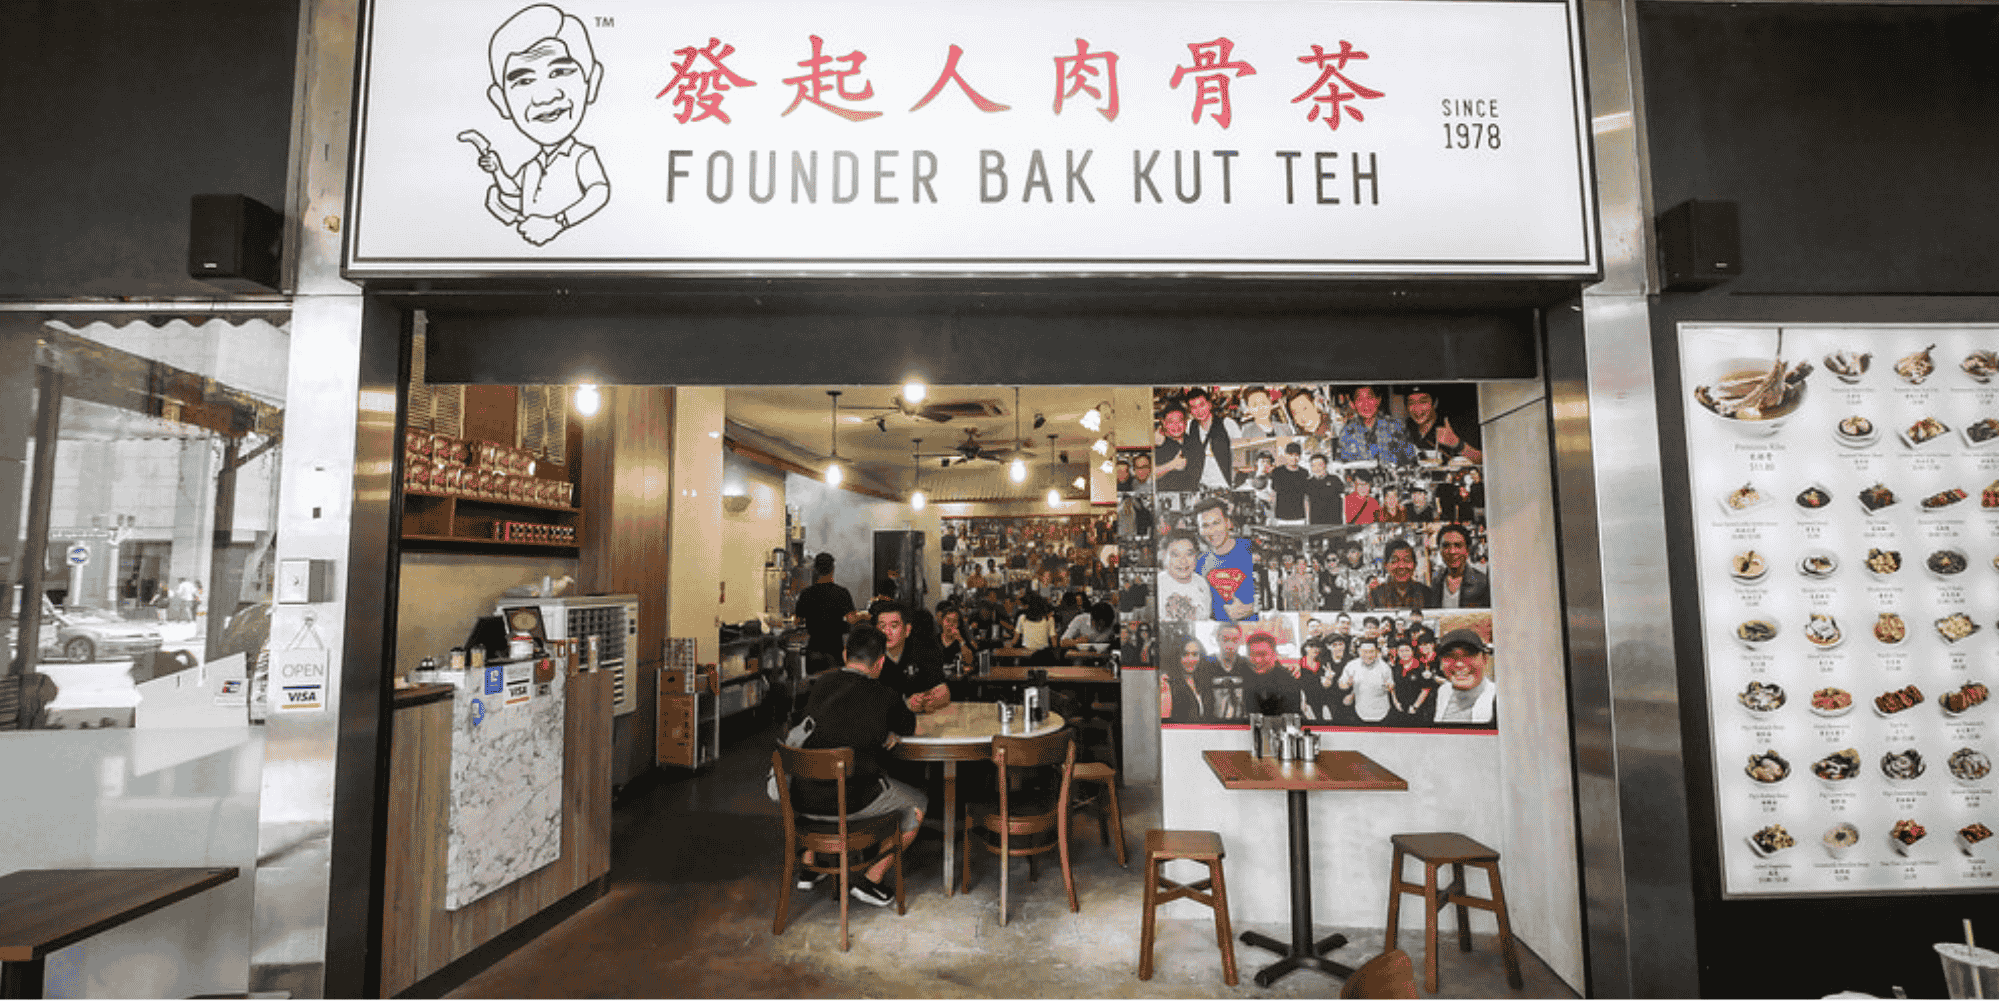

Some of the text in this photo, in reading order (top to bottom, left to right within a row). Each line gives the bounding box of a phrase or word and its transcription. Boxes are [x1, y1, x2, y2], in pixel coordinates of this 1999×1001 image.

[594, 16, 615, 28] TM
[656, 34, 1386, 131] 發起人肉骨茶
[1441, 98, 1499, 118] SINCE
[1443, 122, 1502, 150] 1978
[666, 149, 1381, 207] FOUNDER BAK KUT TEH
[282, 663, 325, 678] OPEN
[287, 691, 317, 703] VISA
